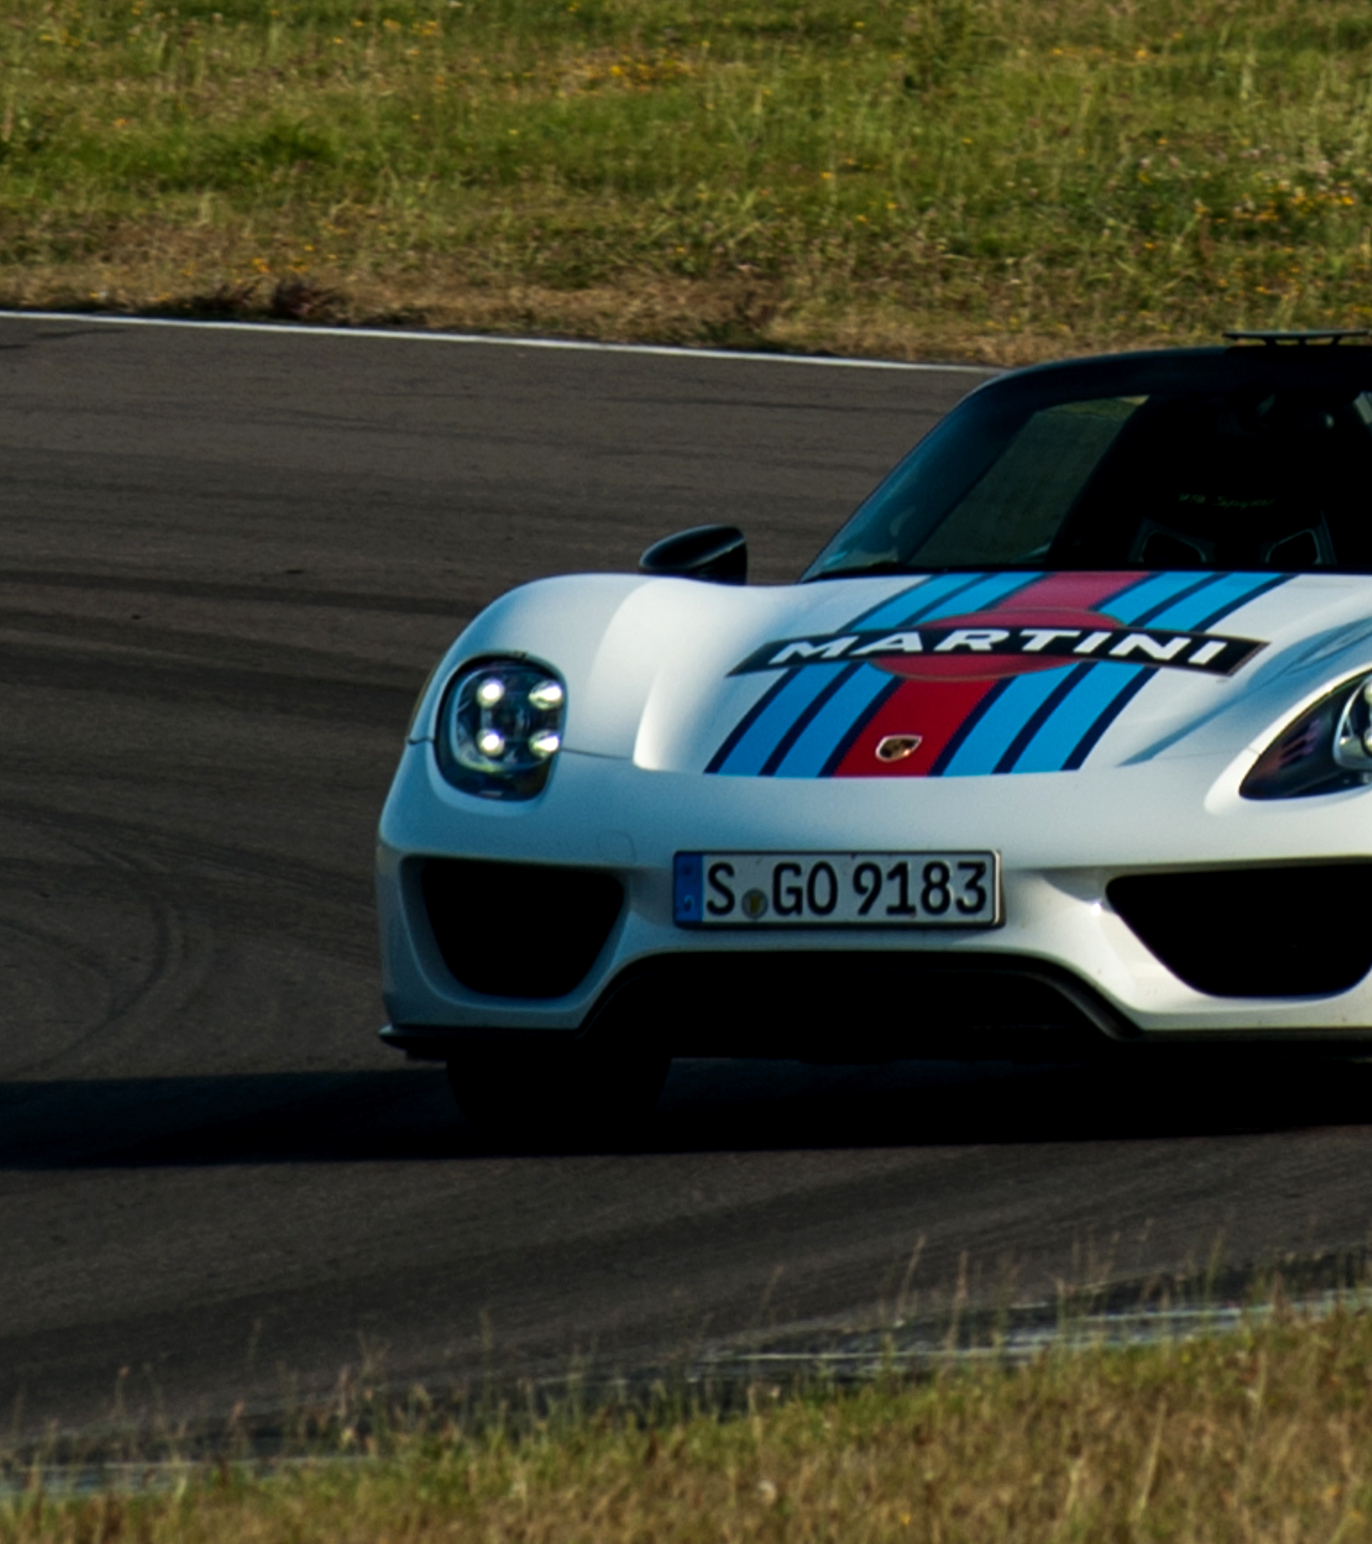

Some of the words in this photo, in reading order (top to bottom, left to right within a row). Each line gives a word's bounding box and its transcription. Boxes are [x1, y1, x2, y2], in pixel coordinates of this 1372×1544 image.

[768, 628, 1227, 665] MARTINI
[706, 861, 735, 916] S
[772, 861, 838, 916] GO
[852, 861, 987, 916] 9183
